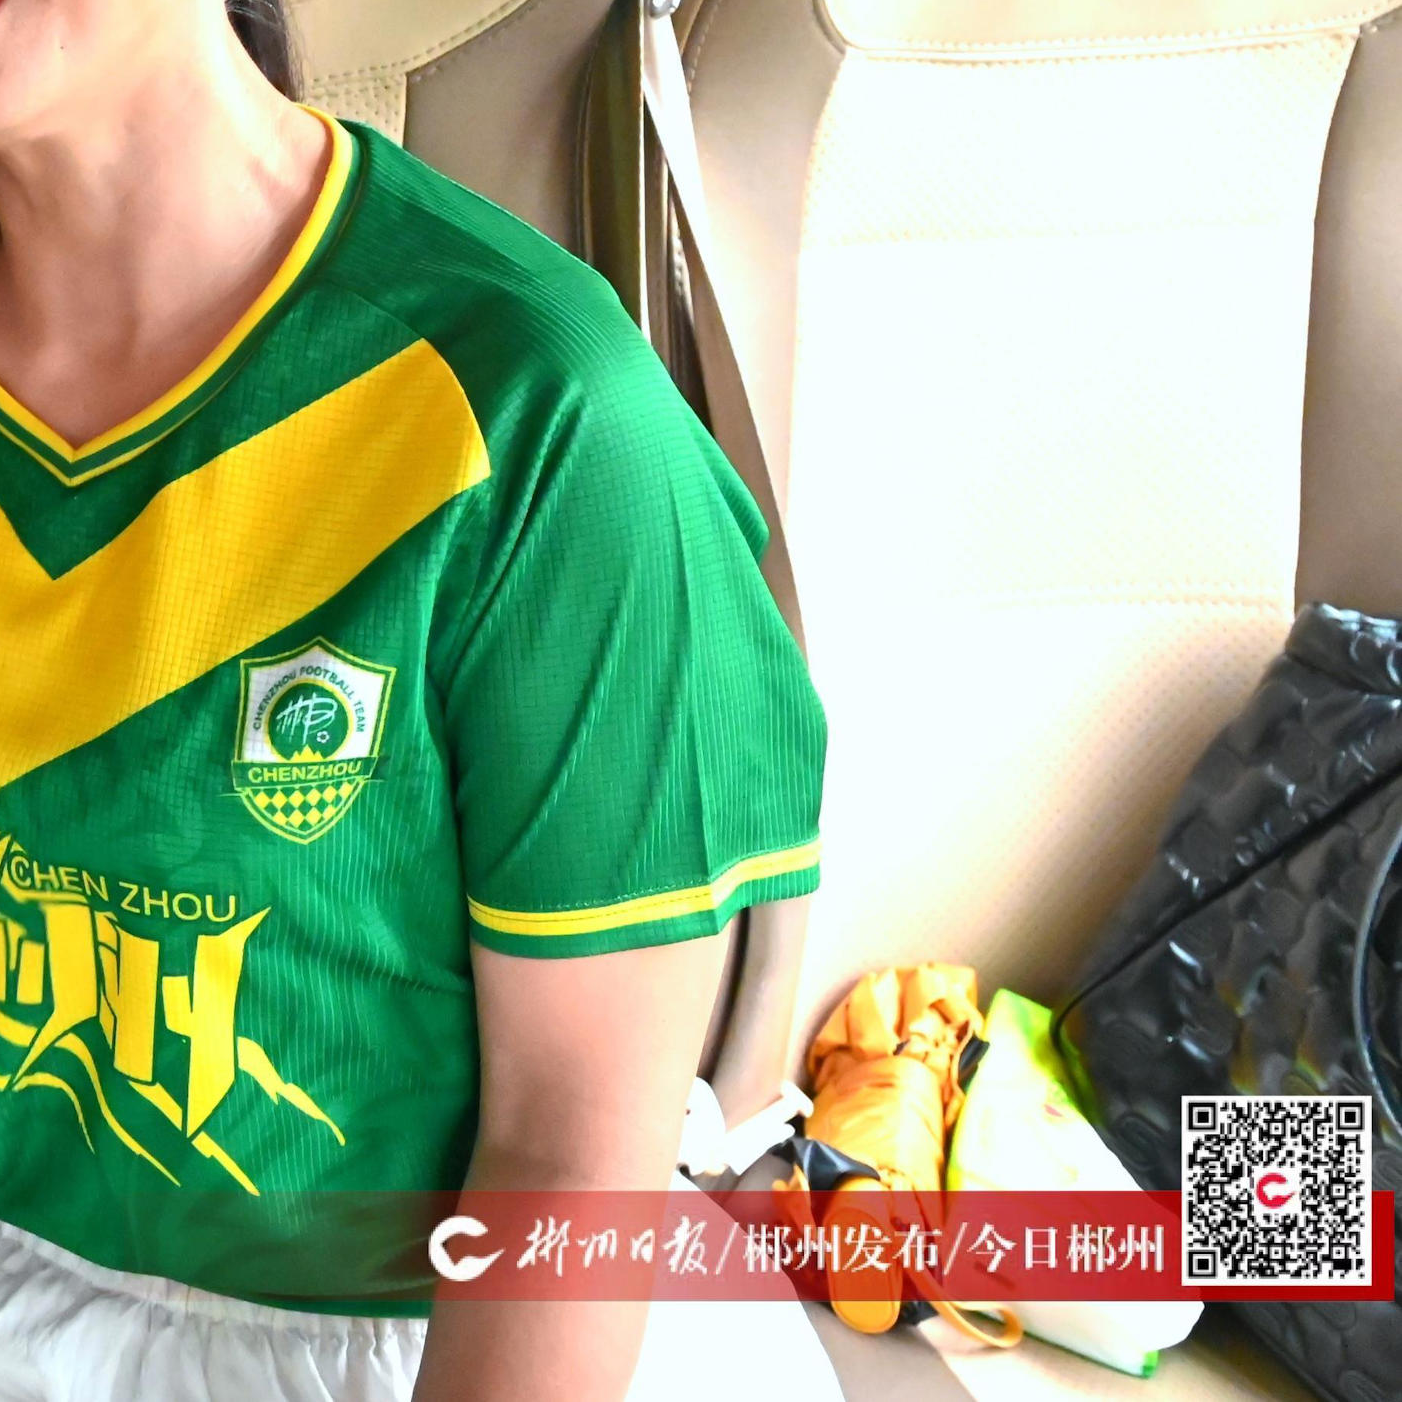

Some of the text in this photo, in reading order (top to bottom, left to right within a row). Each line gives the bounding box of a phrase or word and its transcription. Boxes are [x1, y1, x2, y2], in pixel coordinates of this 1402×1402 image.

[252, 666, 368, 733] CHENZHOU FOOTBALL TEAM
[247, 760, 363, 784] CHENZHOU
[11, 855, 237, 923] CHEN ZHOU
